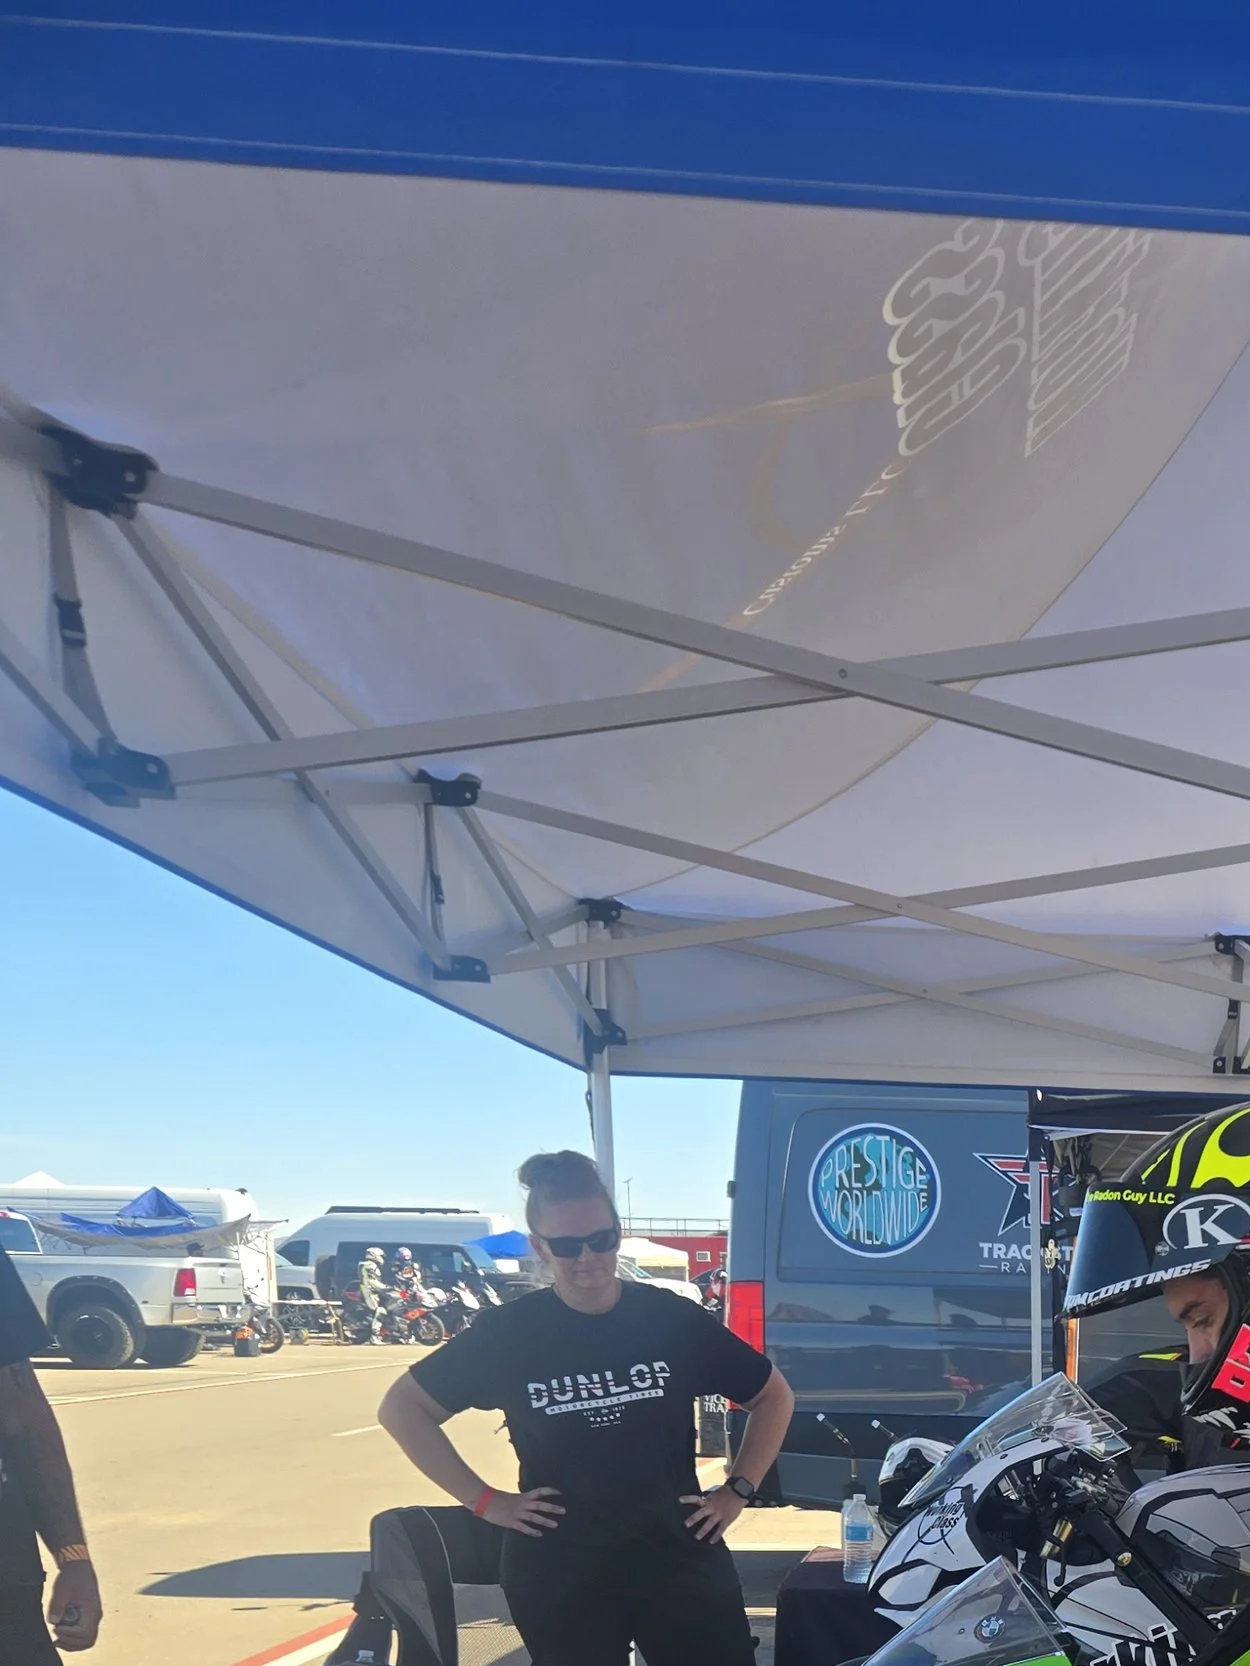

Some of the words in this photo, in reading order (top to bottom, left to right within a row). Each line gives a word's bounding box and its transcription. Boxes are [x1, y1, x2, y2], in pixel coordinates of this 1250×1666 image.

[820, 1135, 928, 1190] PRESTIGE
[820, 1190, 928, 1246] WORLDWIDE
[1122, 1189, 1147, 1205] Guy
[1149, 1191, 1176, 1205] LLC
[527, 1361, 671, 1409] DUNLOP
[550, 1396, 622, 1413] MOTORCYCLE
[629, 1390, 660, 1399] TIRES
